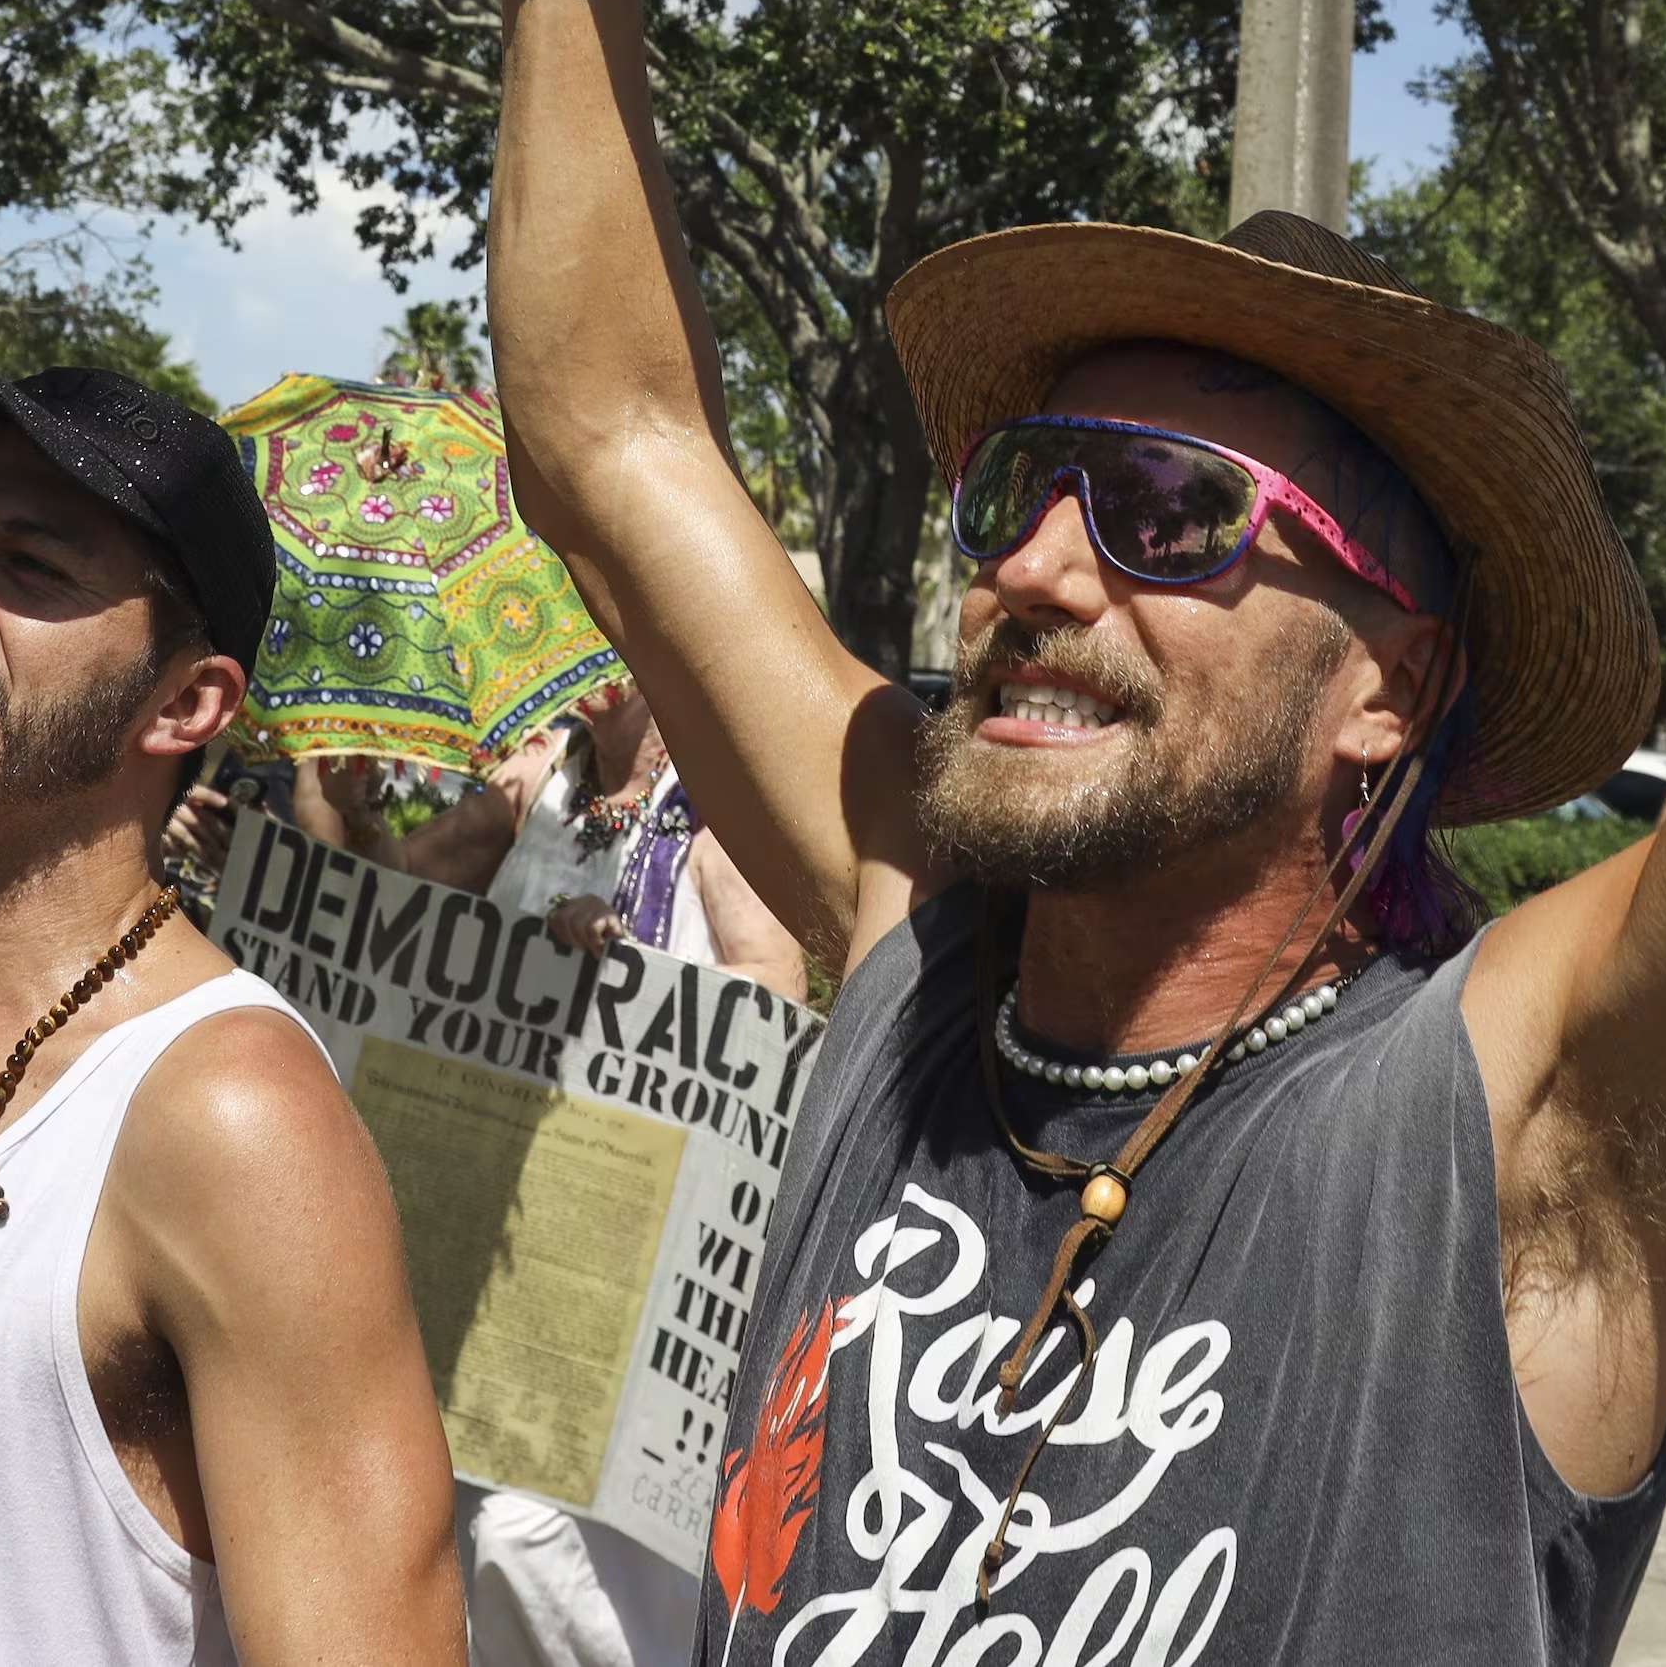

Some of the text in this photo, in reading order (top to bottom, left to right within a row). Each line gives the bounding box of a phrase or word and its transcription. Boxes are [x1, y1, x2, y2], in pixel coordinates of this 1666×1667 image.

[223, 927, 377, 1026] STAND
[406, 996, 565, 1083] YOUR
[240, 820, 826, 1117] DEMOCRACY
[731, 1181, 775, 1240] O
[833, 1182, 1232, 1464] Raise
